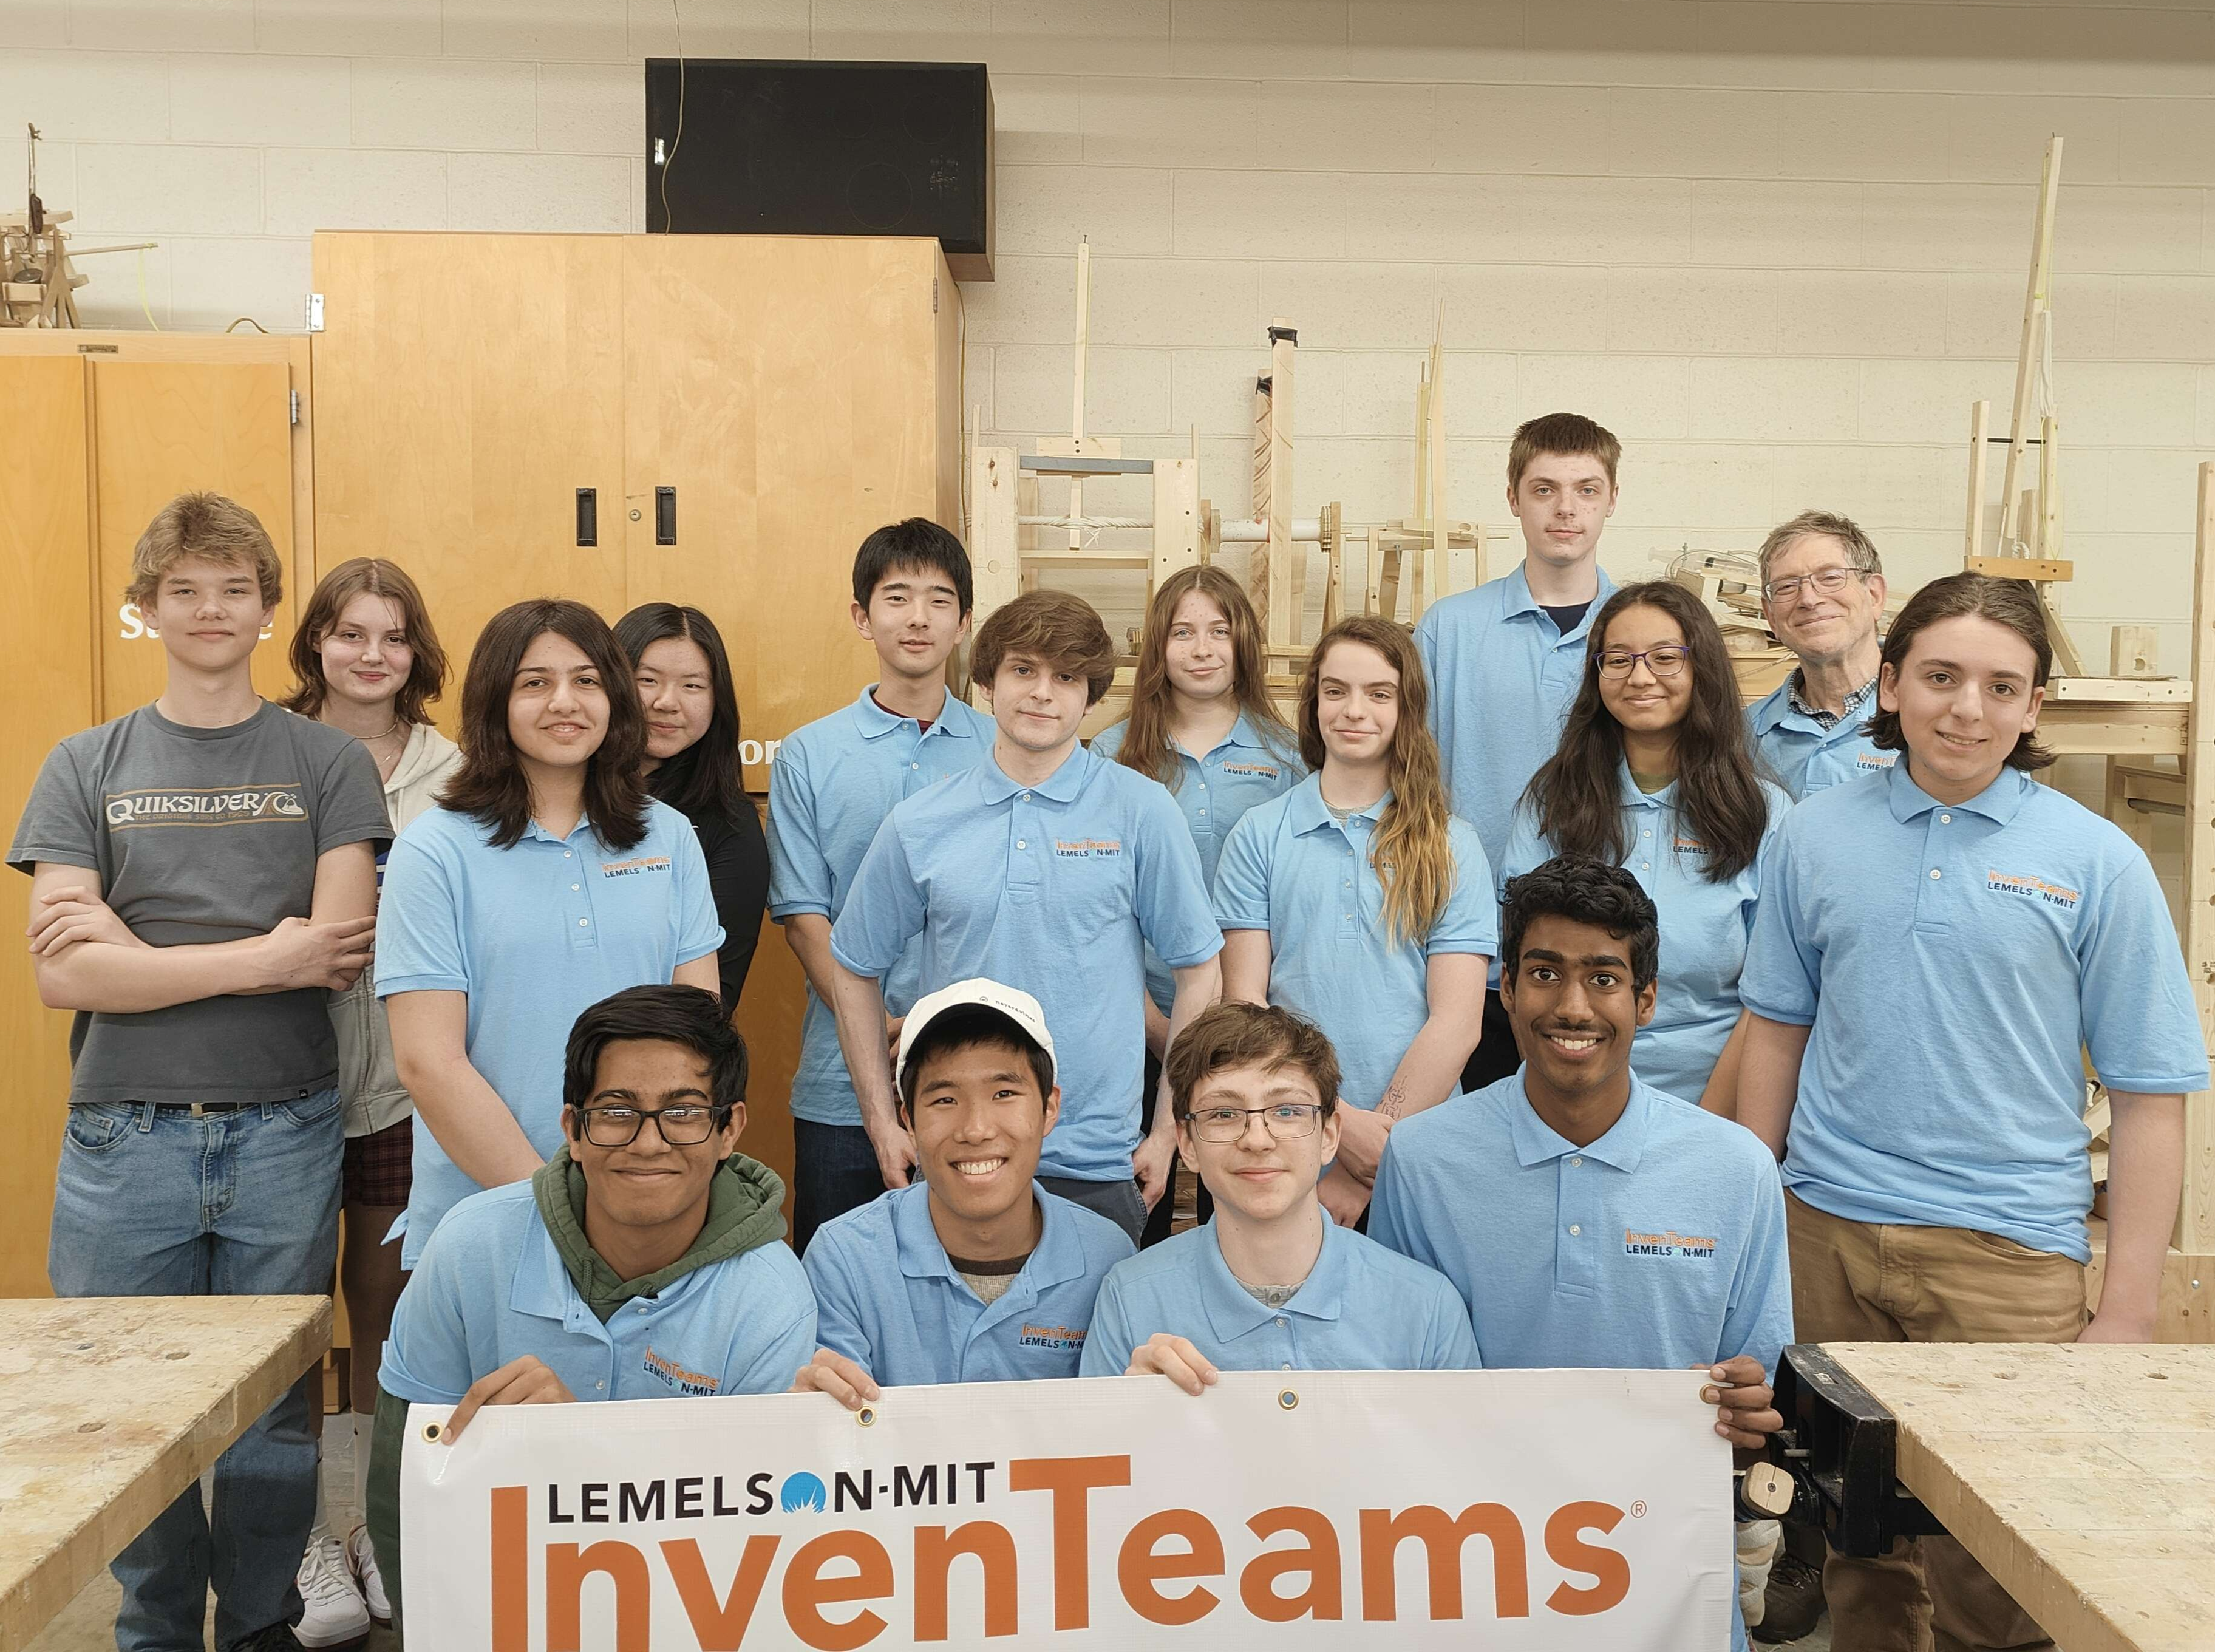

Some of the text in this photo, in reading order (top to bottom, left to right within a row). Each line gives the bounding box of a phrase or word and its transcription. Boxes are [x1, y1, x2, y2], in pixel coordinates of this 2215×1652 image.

[738, 739, 782, 765] or
[1859, 752, 1896, 766] InvenT
[1223, 767, 1278, 780] LEMELSN-MIT
[106, 792, 260, 824] QUIKSILVER
[1056, 849, 1120, 857] LEMELSN-MIT
[604, 864, 670, 878] LEMELSN-MIT
[1626, 1228, 1716, 1248] InvenTeams
[1022, 1323, 1087, 1340] InvenTeam
[1019, 1336, 1084, 1349] LEMELSON-M
[645, 1345, 720, 1389] InvenTeams
